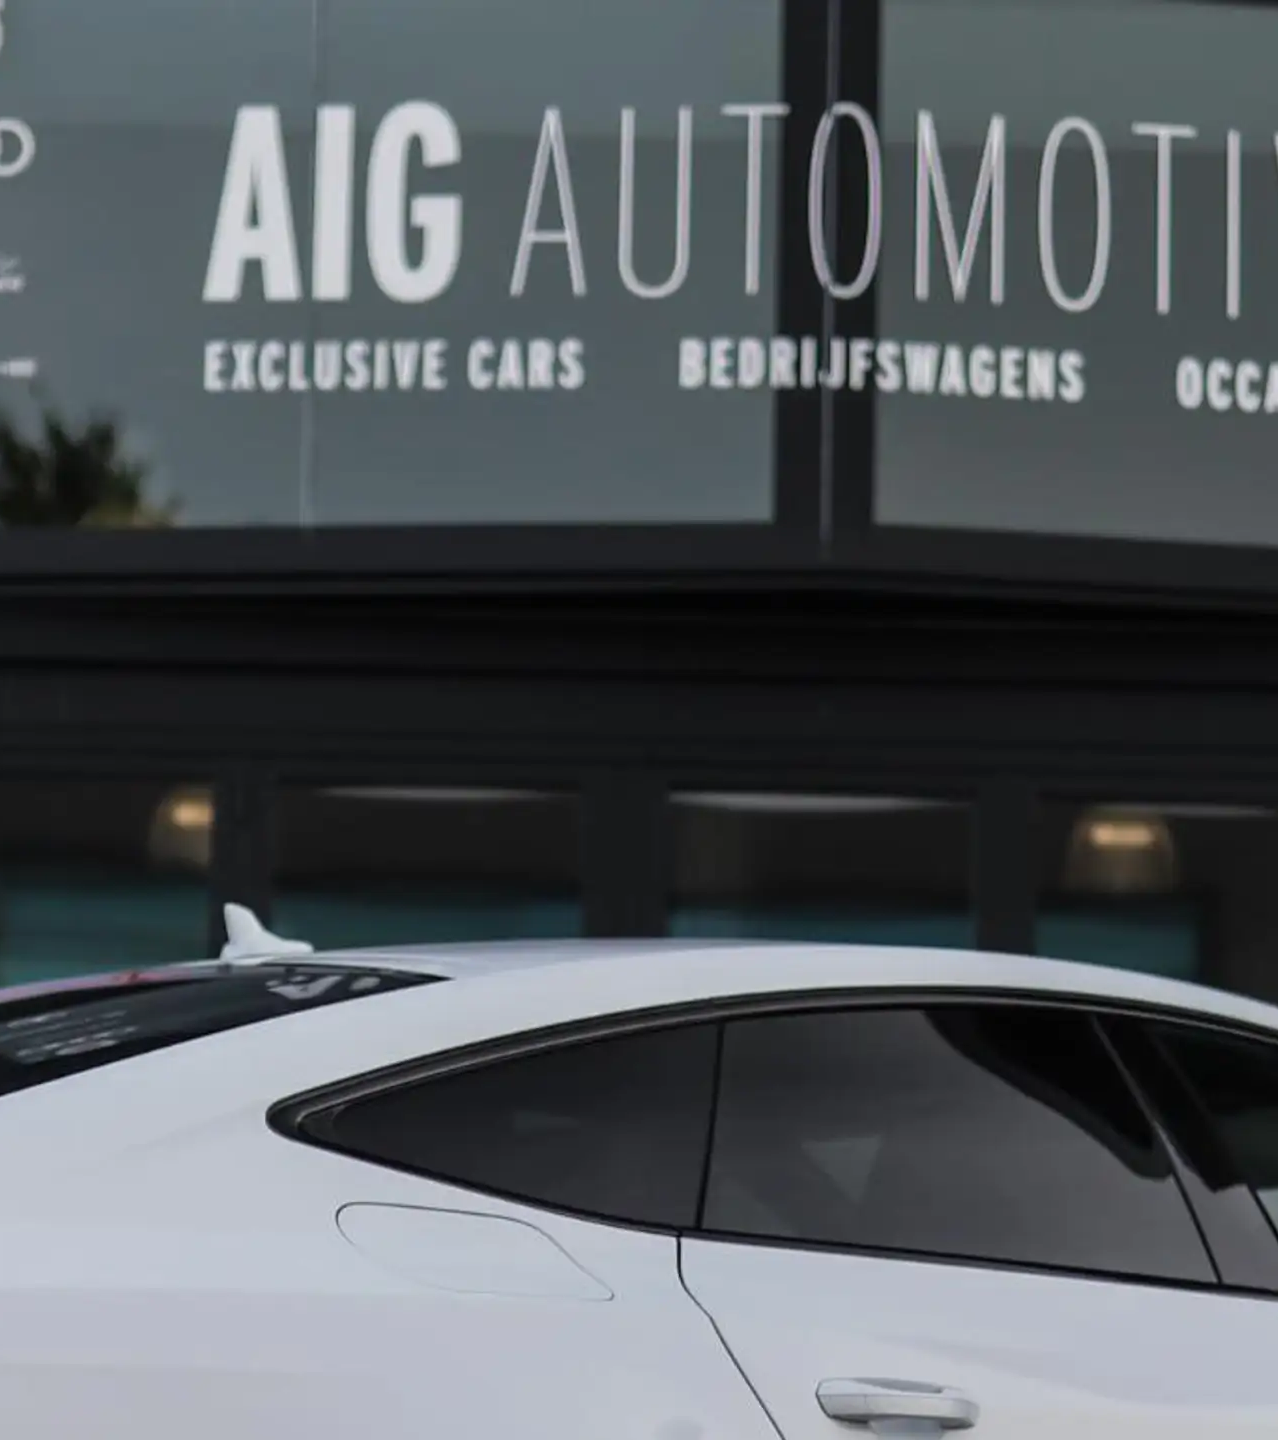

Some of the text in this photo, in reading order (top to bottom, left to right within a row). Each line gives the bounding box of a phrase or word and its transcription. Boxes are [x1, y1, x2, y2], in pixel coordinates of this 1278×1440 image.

[202, 100, 464, 304] AIG
[203, 338, 586, 391] EXCLUSIVE CARS
[678, 337, 1086, 404] BEDRIJFSWAGENS
